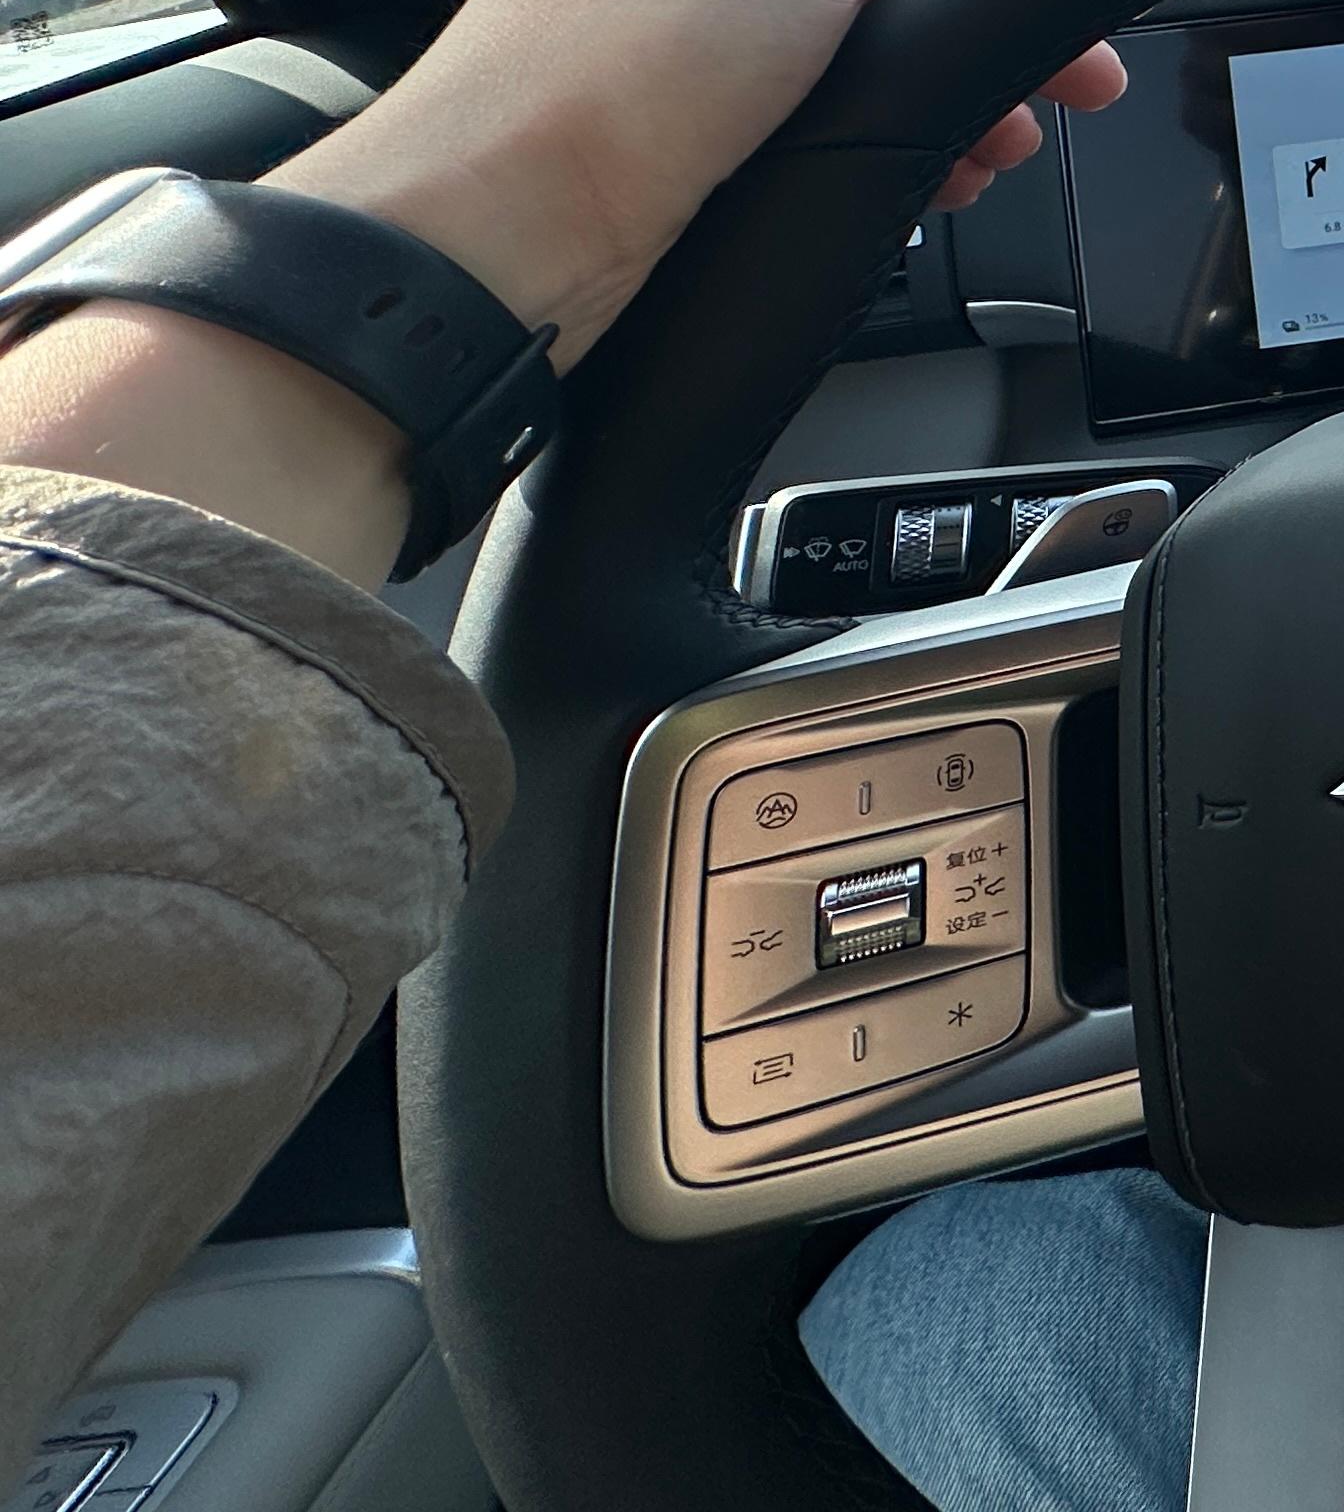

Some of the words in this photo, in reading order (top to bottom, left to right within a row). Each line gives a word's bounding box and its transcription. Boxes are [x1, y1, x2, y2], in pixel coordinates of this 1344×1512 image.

[1305, 312, 1329, 325] 13%
[833, 558, 869, 574] AUTO
[945, 911, 988, 935] 设定
